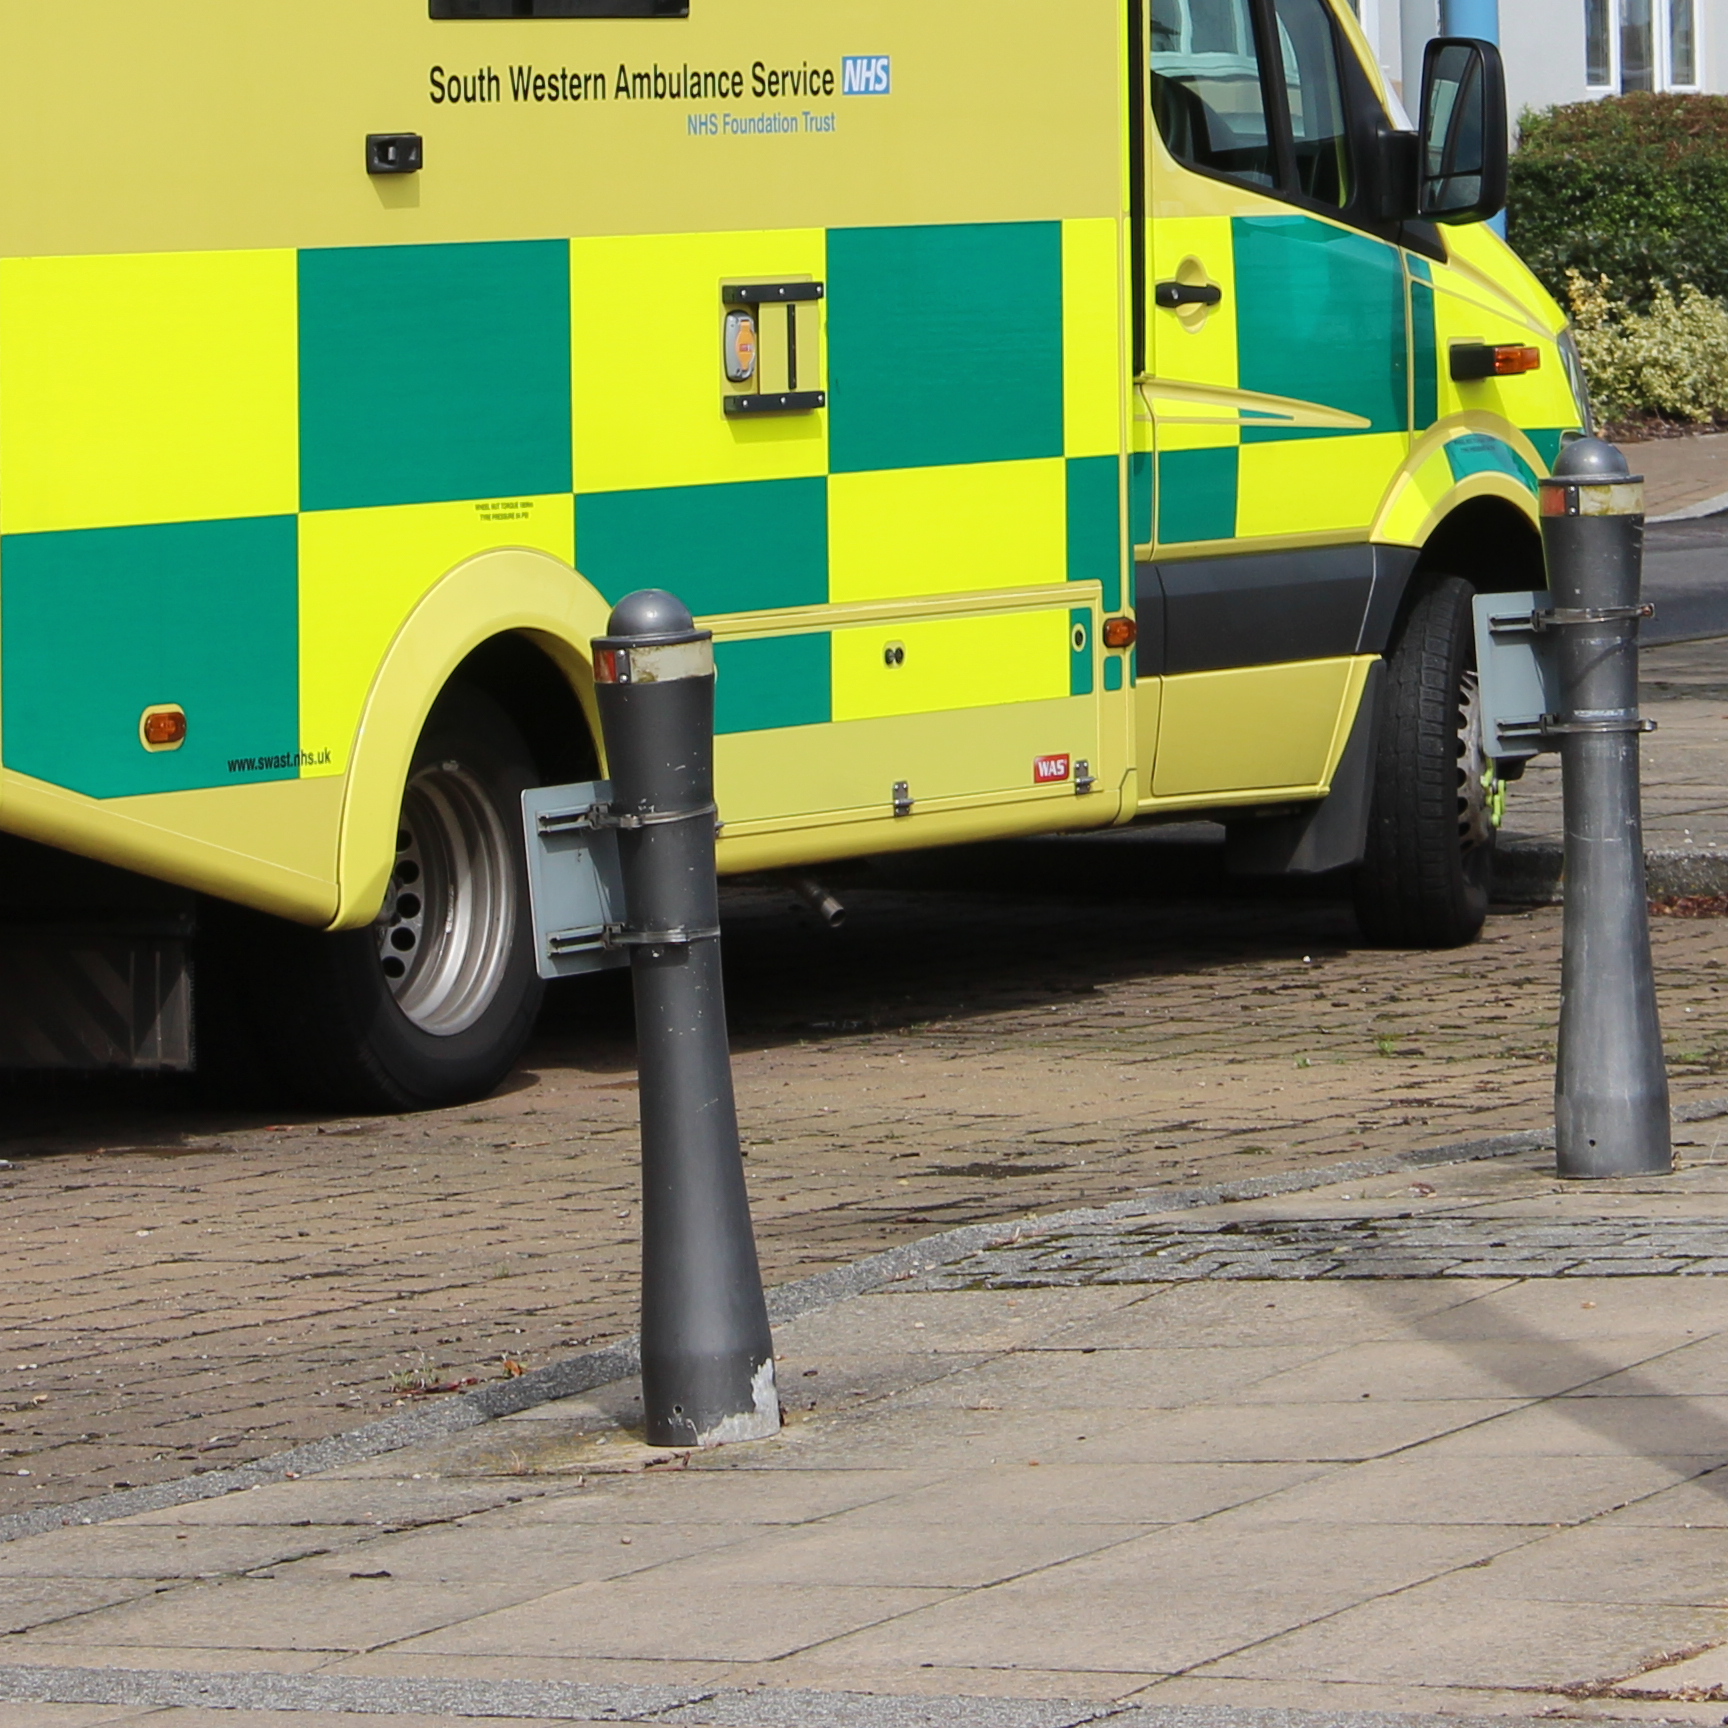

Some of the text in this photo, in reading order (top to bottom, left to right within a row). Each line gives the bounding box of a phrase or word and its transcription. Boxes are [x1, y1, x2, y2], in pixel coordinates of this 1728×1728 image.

[429, 58, 888, 104] South Western Ambulance Service NHS
[688, 111, 836, 135] NHS Foundation Trust
[227, 747, 331, 773] www.swast.nhs.uk
[1037, 758, 1065, 777] WAS
